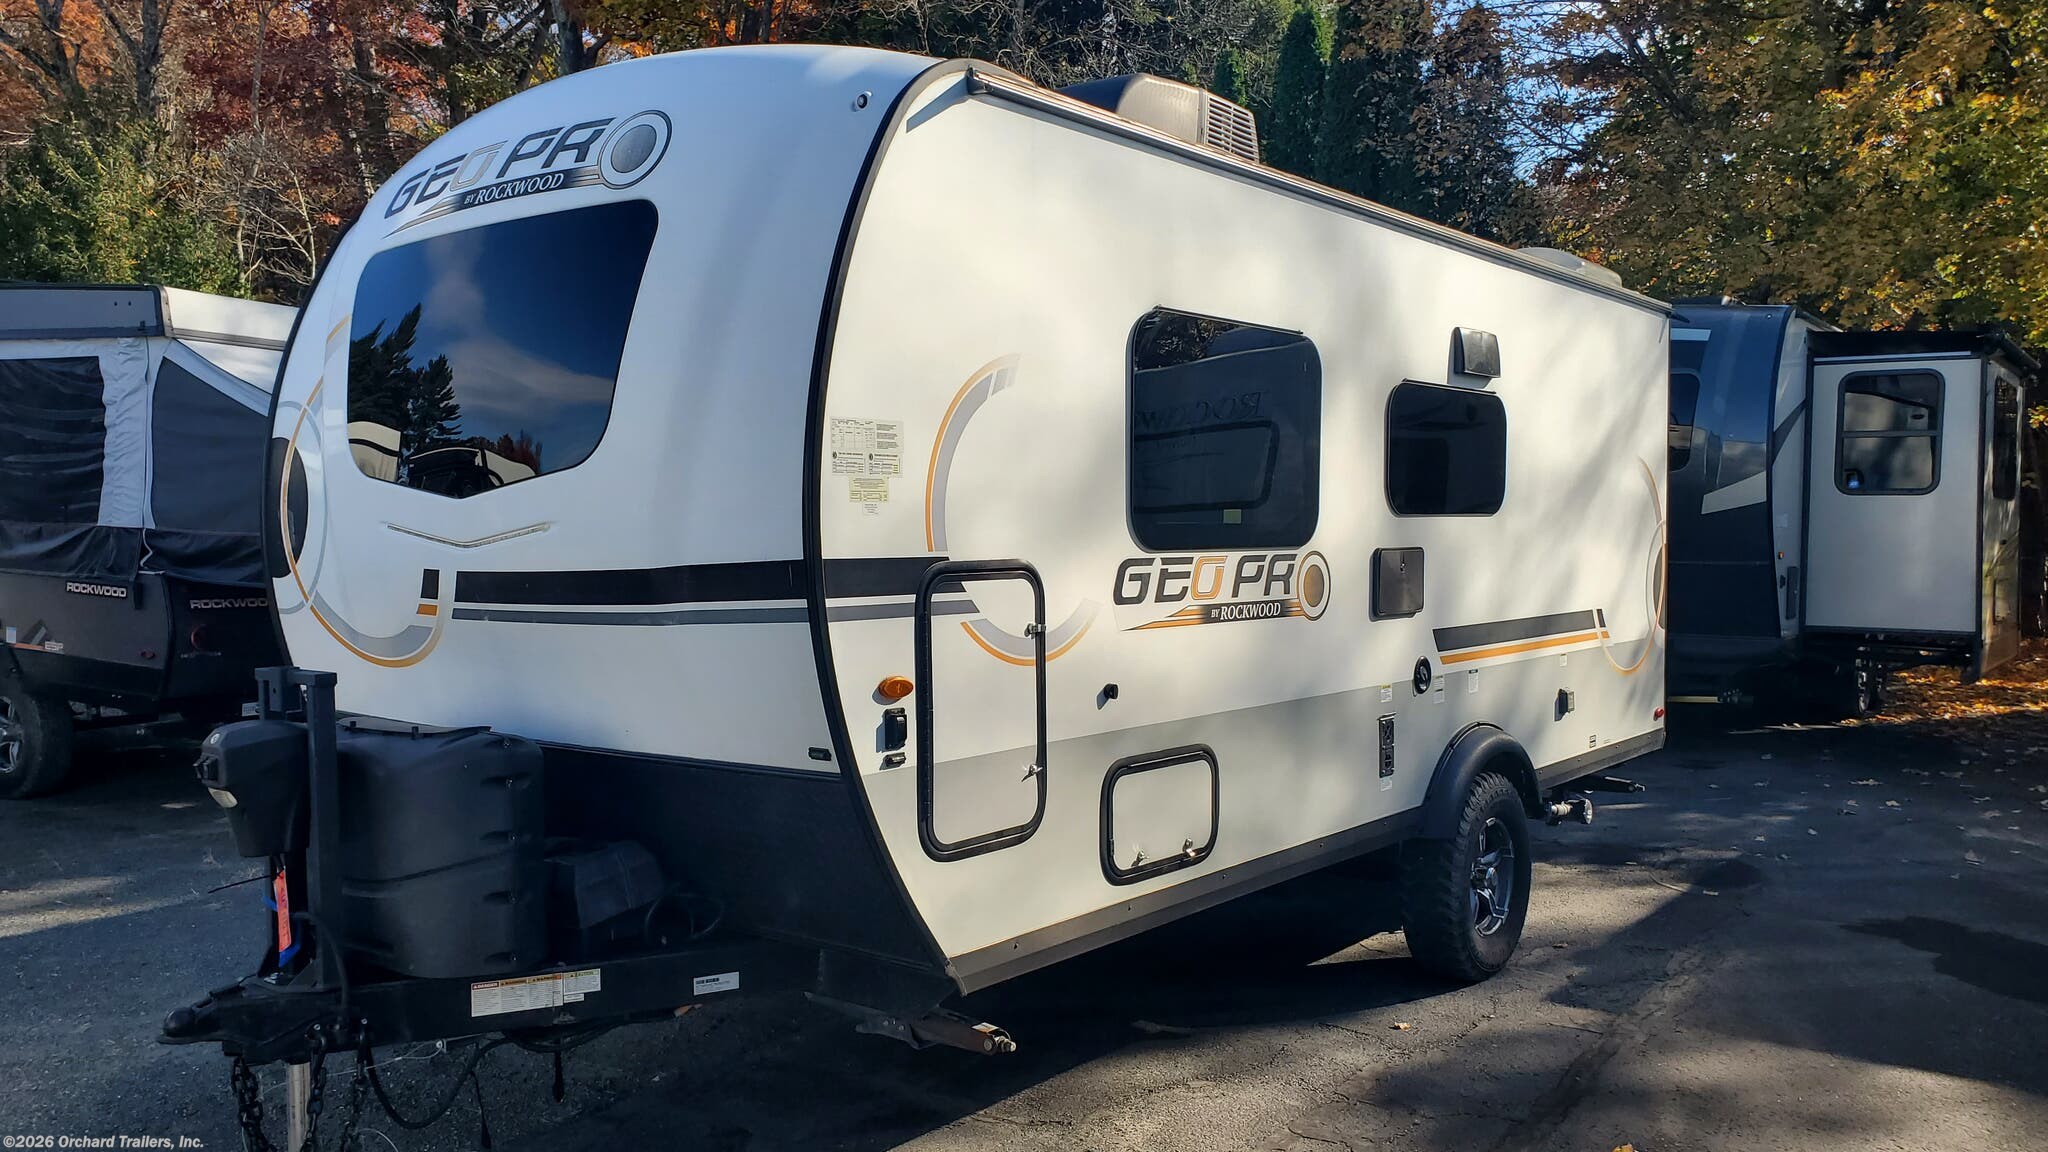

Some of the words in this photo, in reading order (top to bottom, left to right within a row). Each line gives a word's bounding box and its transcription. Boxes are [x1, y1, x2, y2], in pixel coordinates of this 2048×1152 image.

[383, 139, 508, 220] GEO
[464, 194, 477, 205] BY
[474, 173, 564, 205] ROCKWOOD
[66, 582, 127, 598] ROCKWOOD
[1112, 555, 1229, 606] GEO
[190, 598, 268, 609] ROCKWOO
[1210, 609, 1221, 619] BY
[1219, 602, 1282, 621] ROCKWOOD
